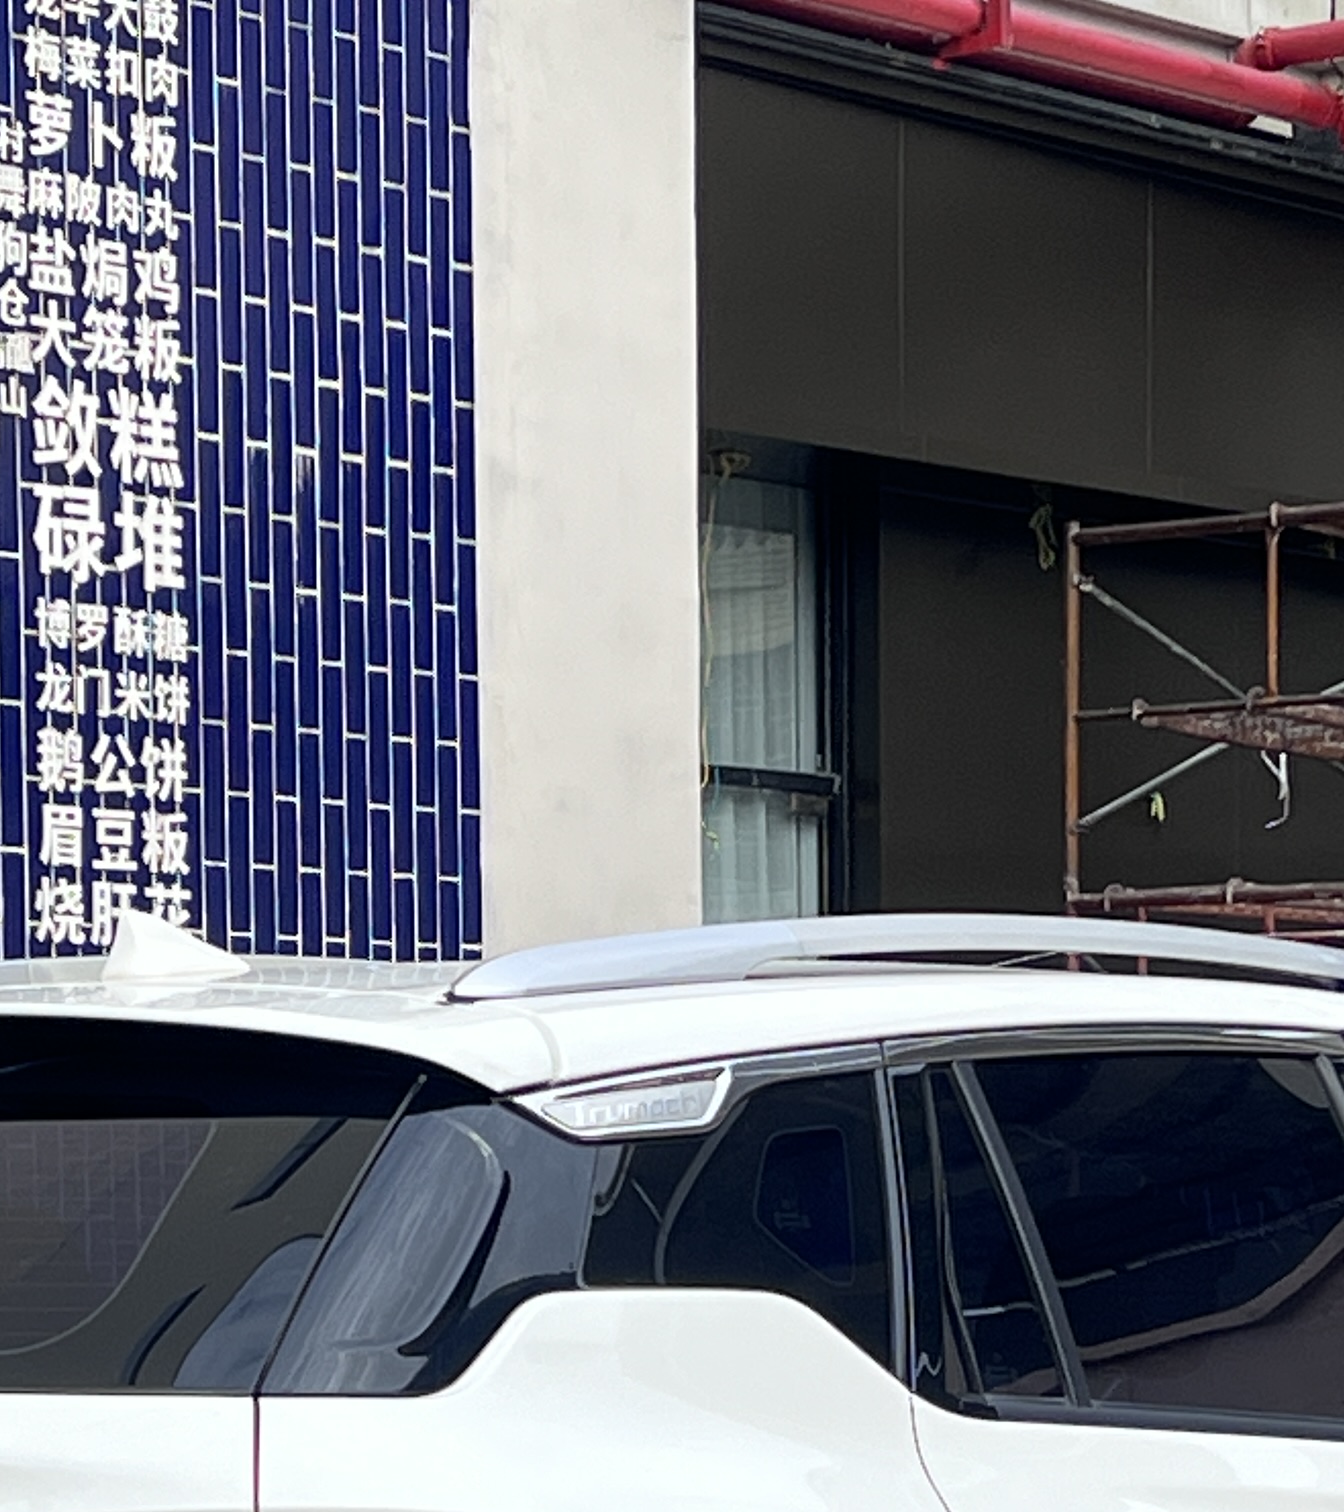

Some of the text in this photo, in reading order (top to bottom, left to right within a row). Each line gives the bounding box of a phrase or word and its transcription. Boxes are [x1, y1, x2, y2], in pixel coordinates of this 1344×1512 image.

[24, 25, 178, 107] 梅菜扣肉
[28, 167, 179, 240] 麻陂肉丸
[29, 225, 179, 314] 盐焗鸡
[33, 484, 186, 592] 碌堆
[35, 597, 188, 663] 博罗酥糖
[36, 662, 190, 725] 龙门米饼
[37, 726, 188, 802] 鹅公饼
